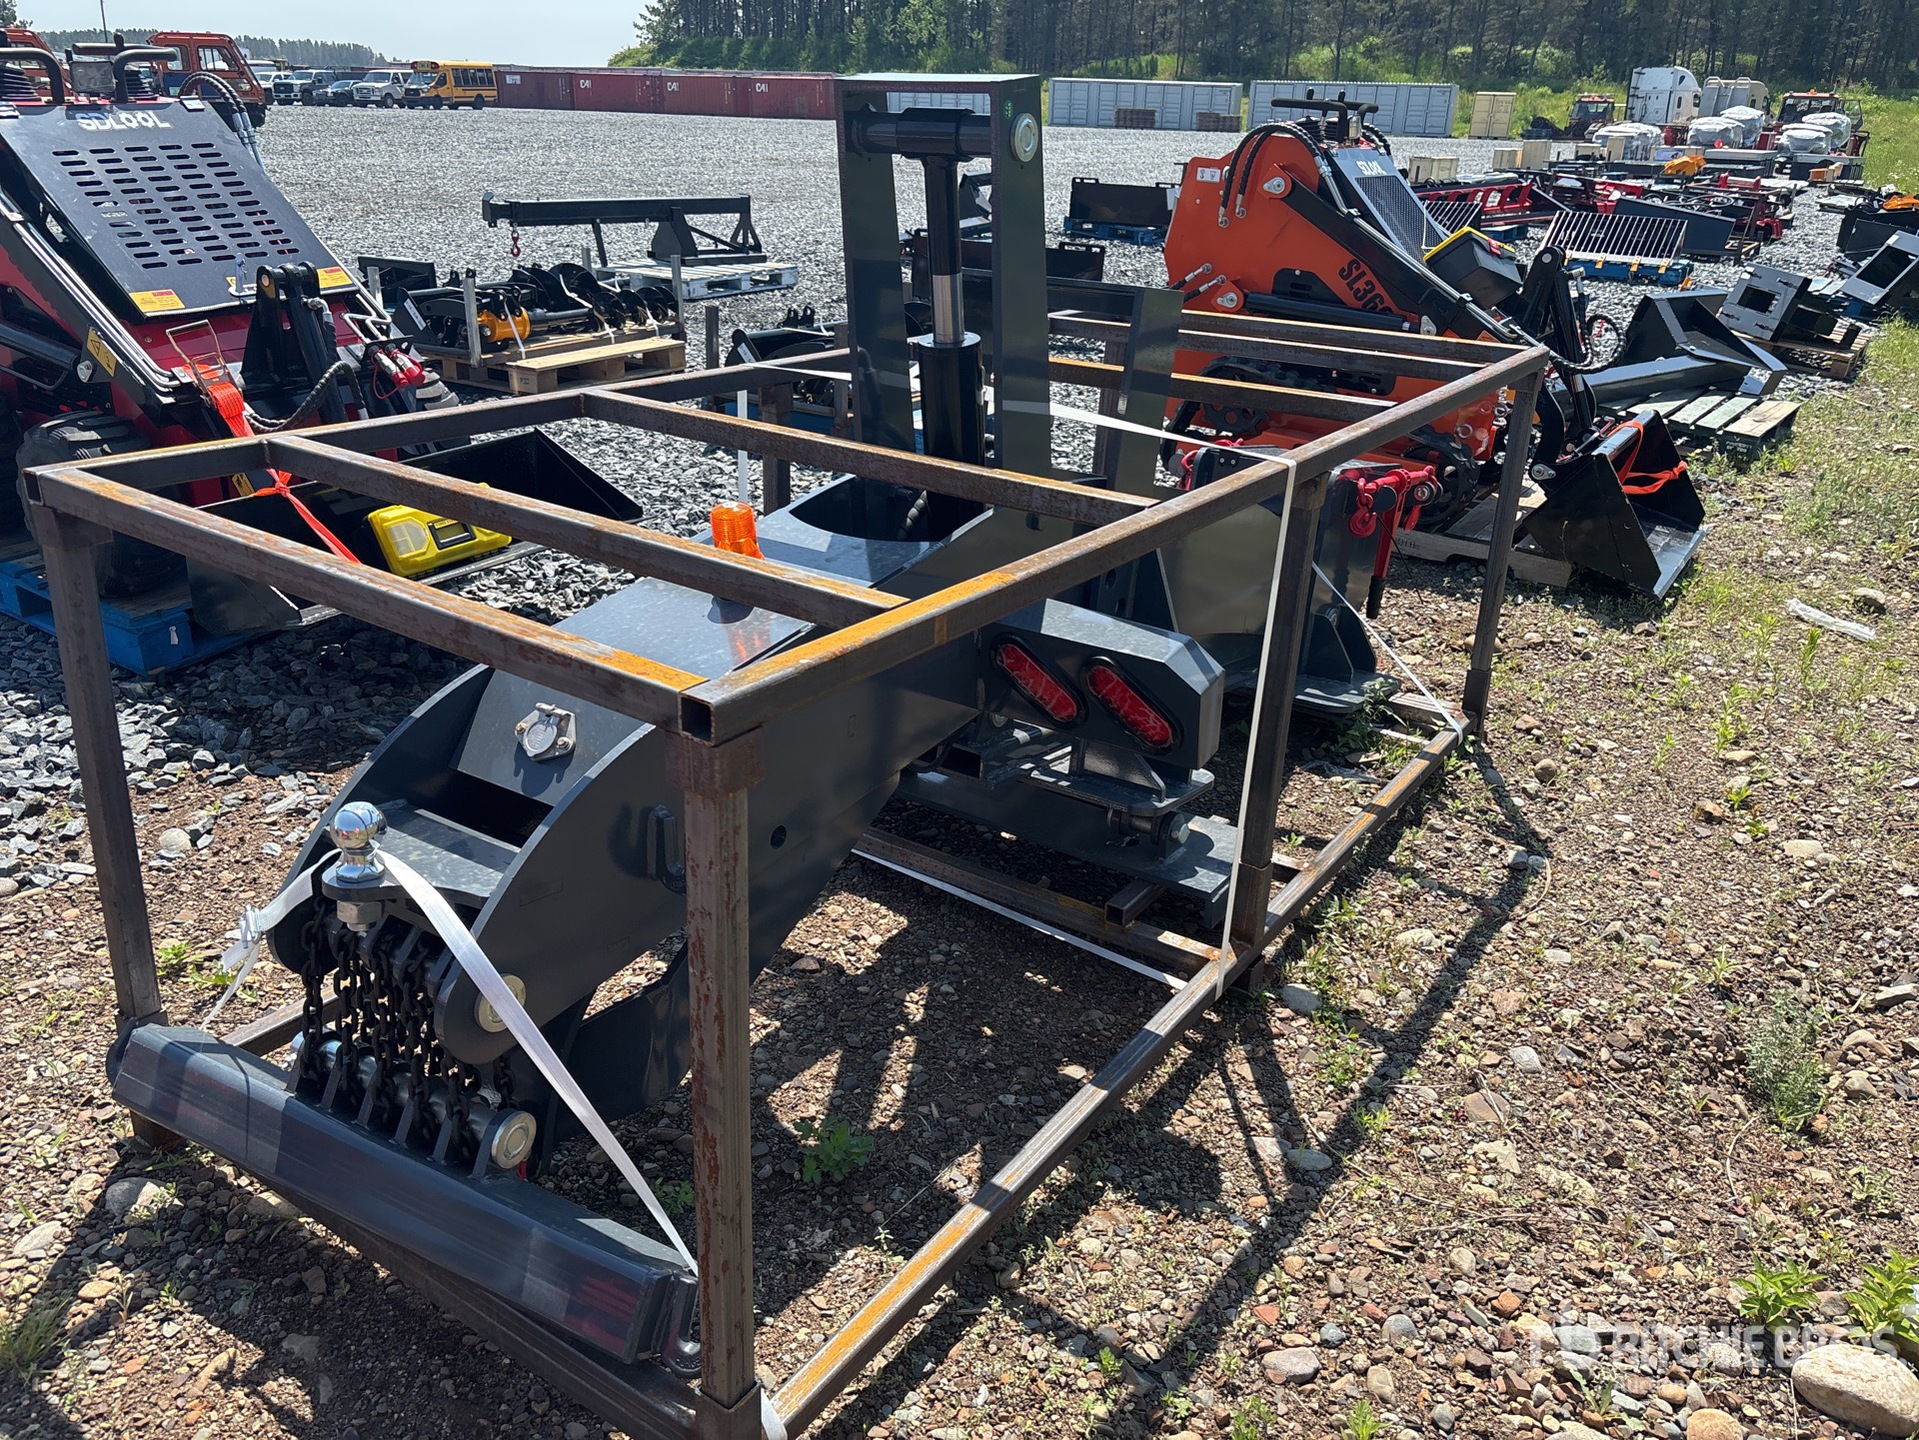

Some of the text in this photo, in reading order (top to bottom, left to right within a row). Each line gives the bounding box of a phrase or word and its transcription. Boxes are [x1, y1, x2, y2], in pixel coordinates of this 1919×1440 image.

[580, 79, 592, 89] CAI
[667, 81, 680, 92] CAI
[755, 82, 769, 93] CAI
